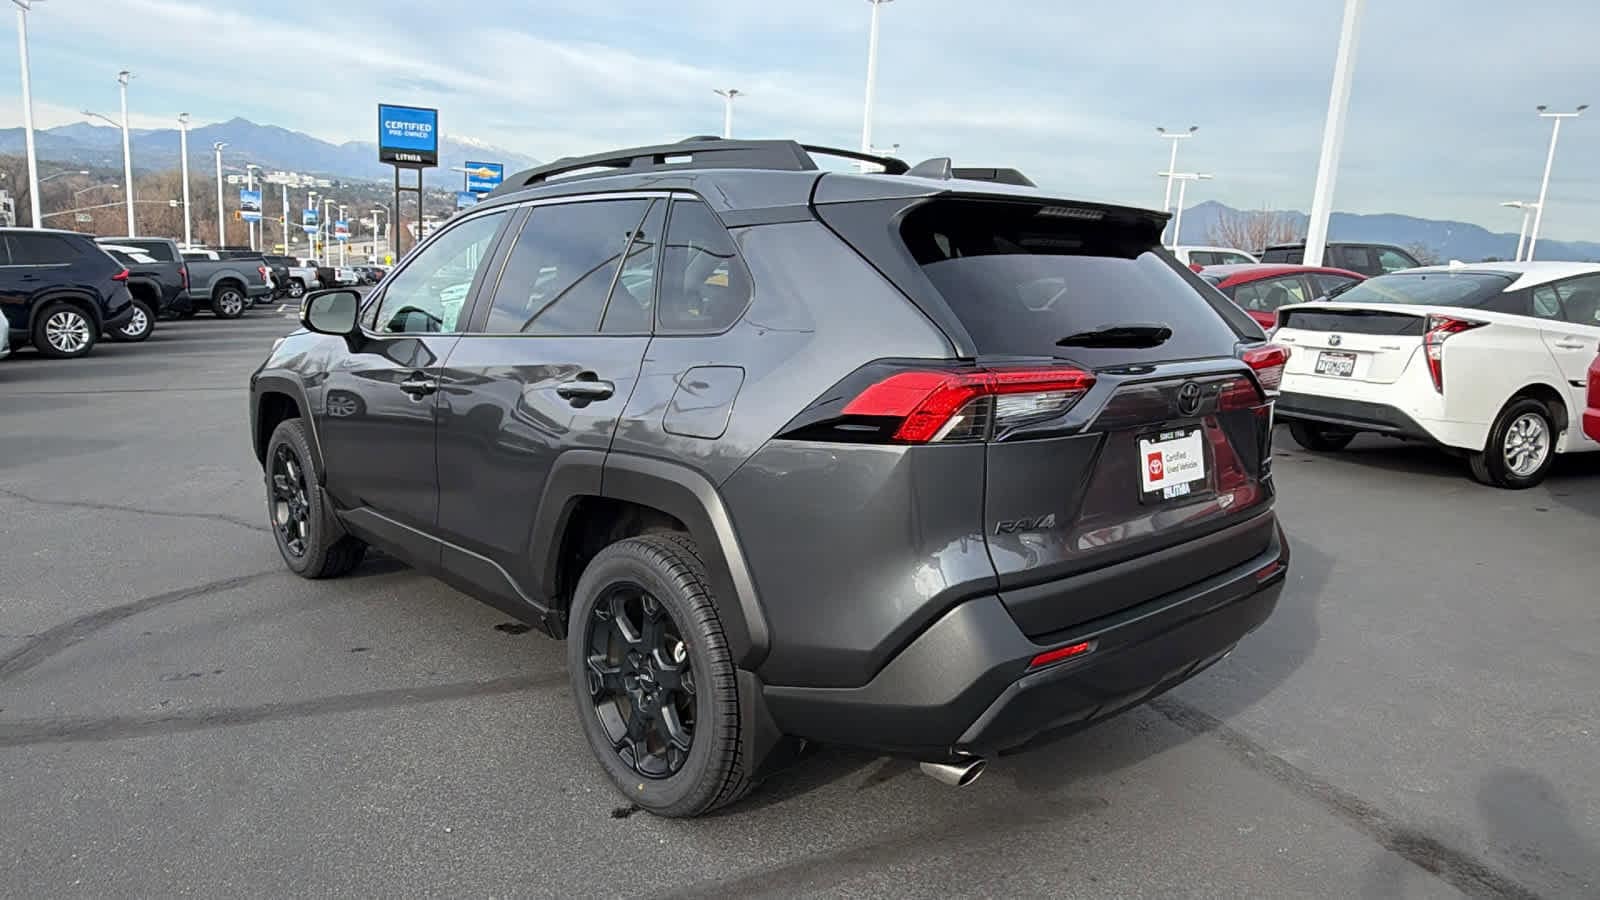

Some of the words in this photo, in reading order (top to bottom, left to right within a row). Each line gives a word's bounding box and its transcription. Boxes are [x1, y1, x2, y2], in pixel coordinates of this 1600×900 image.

[385, 120, 432, 132] CERTIFIED
[389, 129, 429, 139] PRE-OWNED
[395, 153, 422, 162] LITHIA
[1166, 451, 1187, 462] Certified
[1180, 461, 1198, 470] Vehicles
[994, 513, 1056, 535] RAV4
